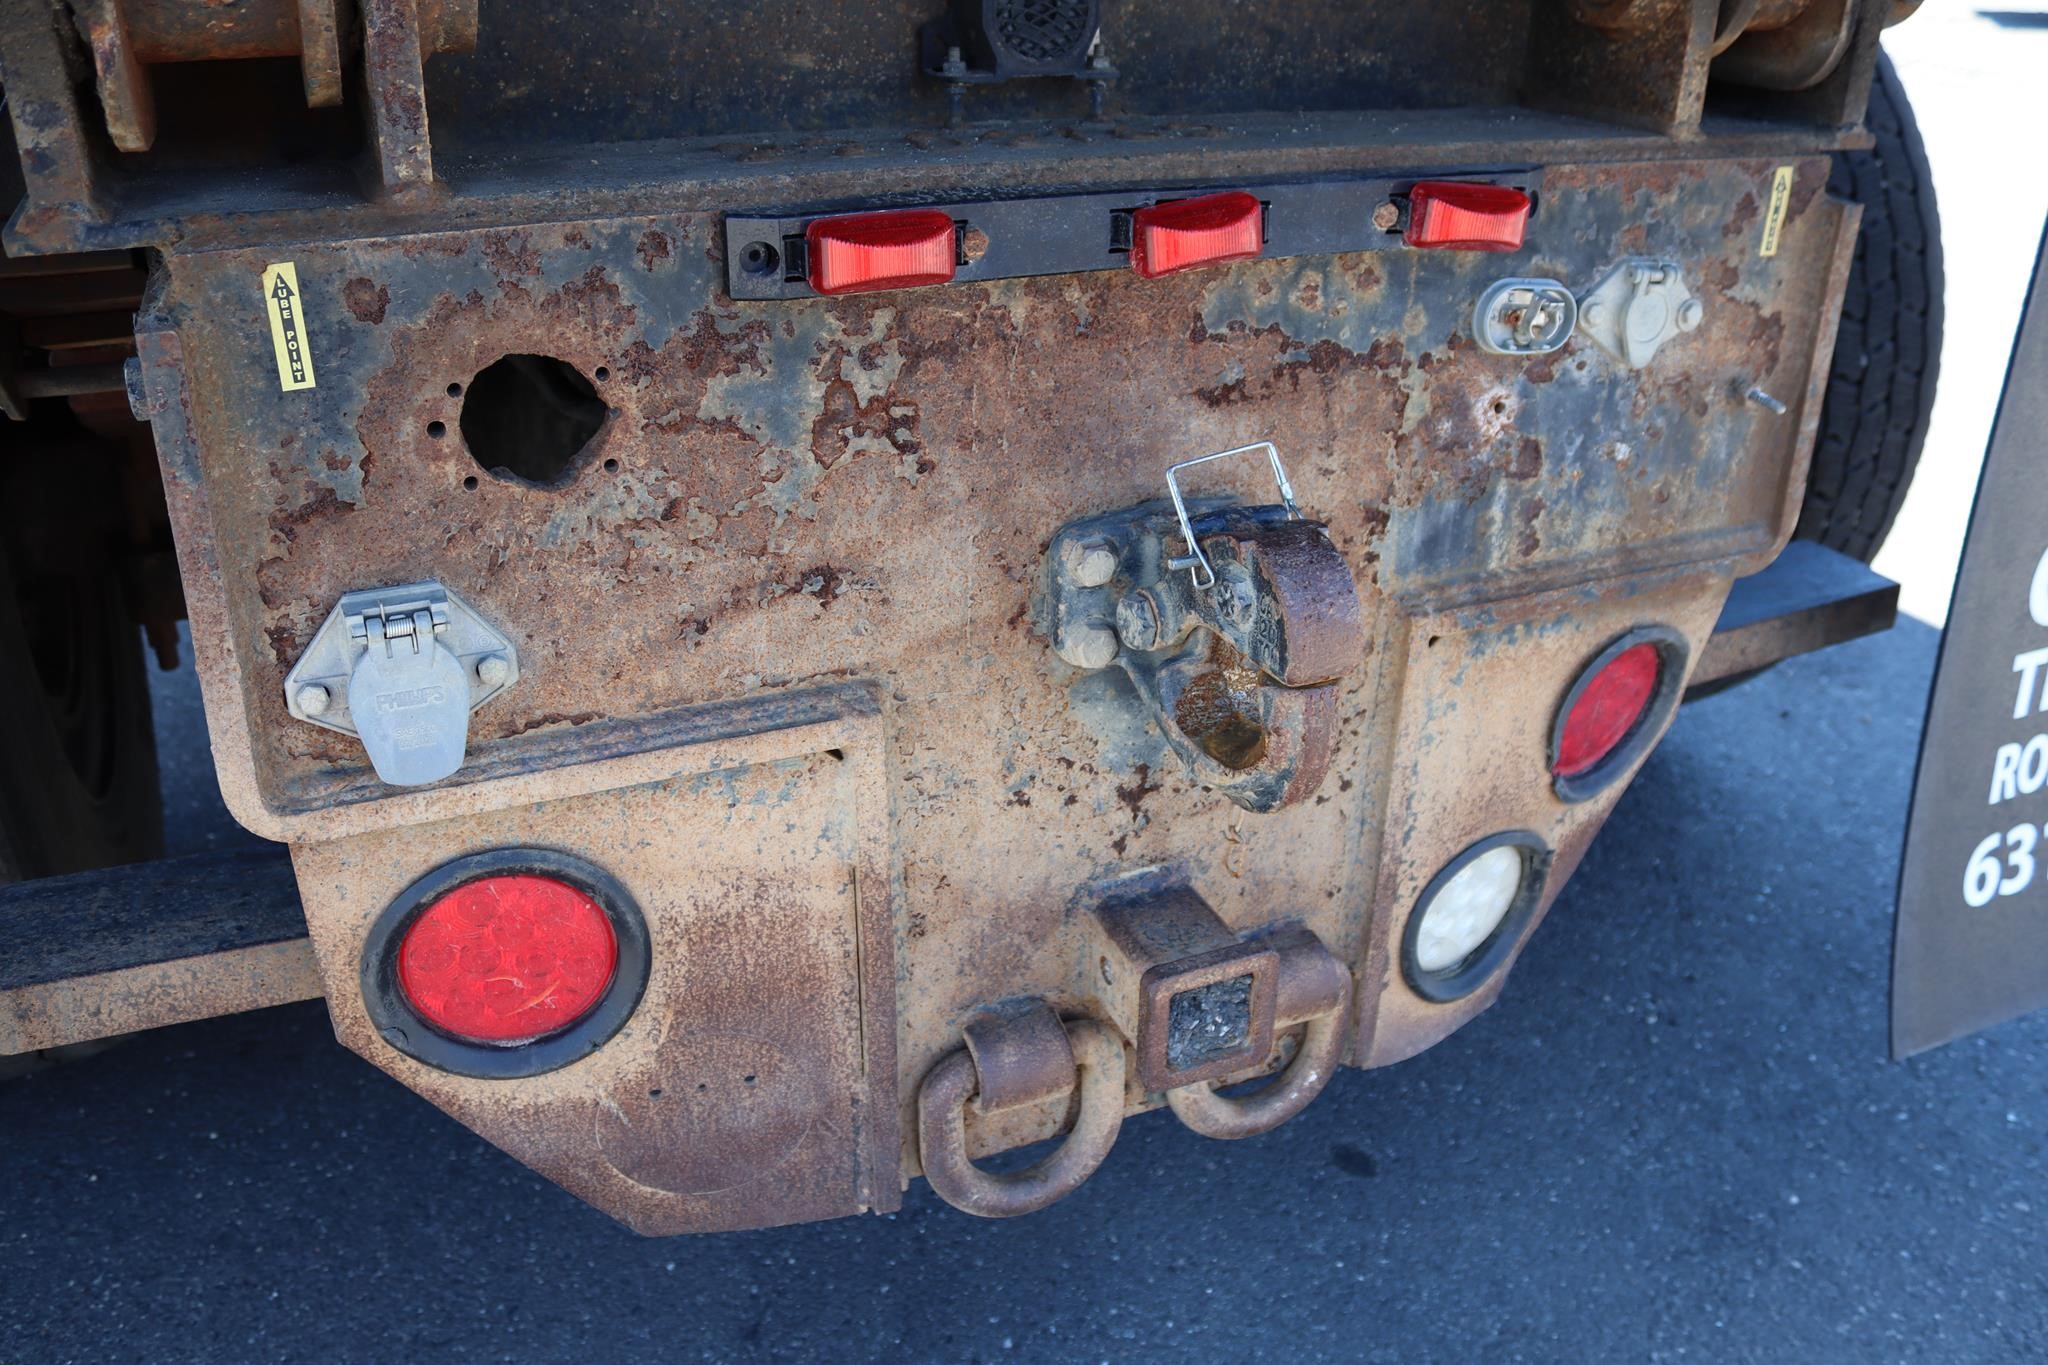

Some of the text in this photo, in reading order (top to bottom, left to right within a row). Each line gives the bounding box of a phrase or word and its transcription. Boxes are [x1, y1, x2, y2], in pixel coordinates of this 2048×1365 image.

[276, 278, 303, 381] LUBE POINT
[2012, 647, 2048, 720] T
[1988, 733, 2048, 805] RO
[1963, 822, 2048, 907] 63
